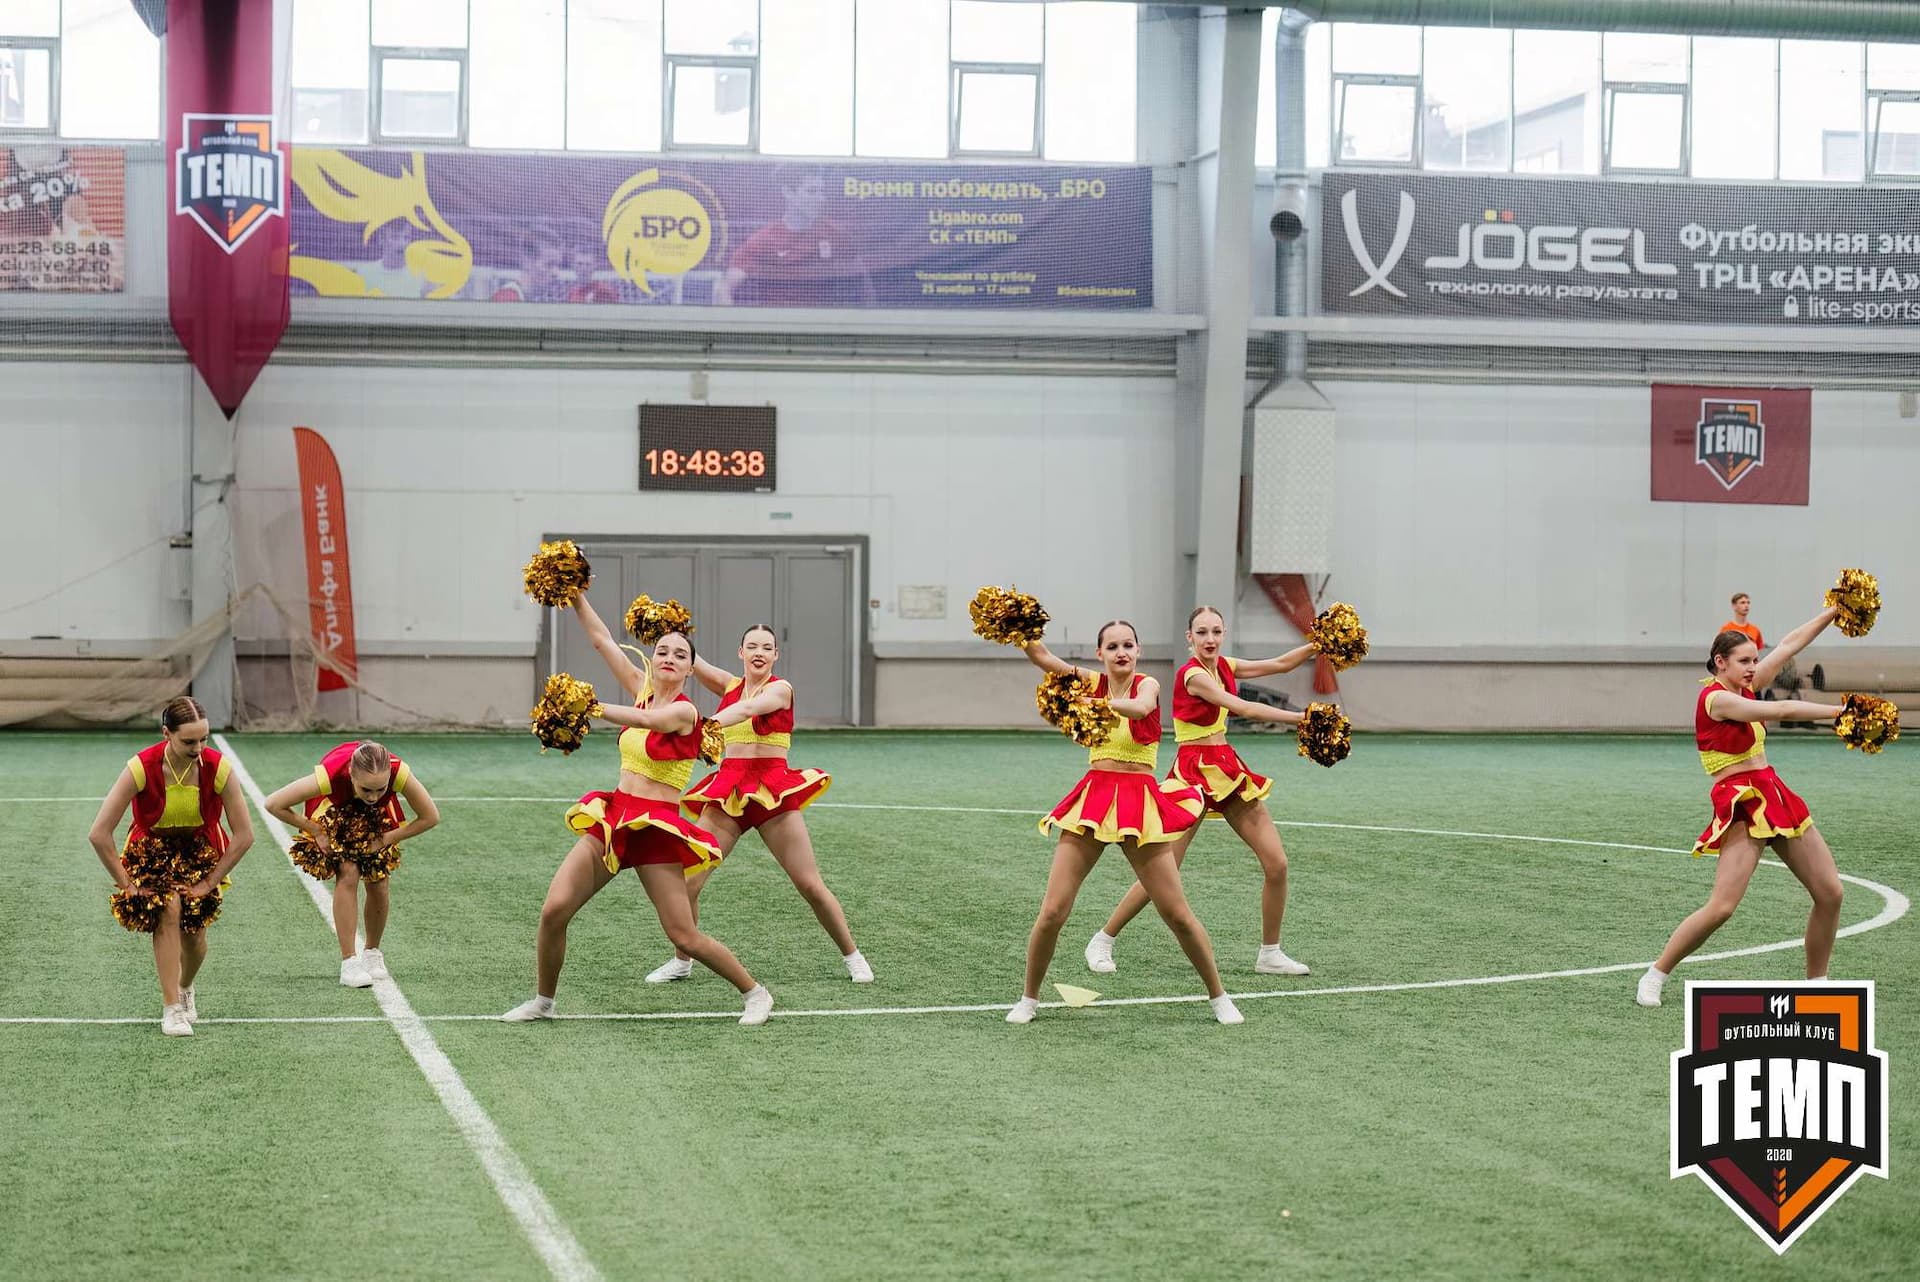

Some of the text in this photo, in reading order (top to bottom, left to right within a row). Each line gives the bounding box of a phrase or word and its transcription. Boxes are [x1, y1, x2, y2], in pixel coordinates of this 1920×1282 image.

[30, 168, 90, 203] 20%
[187, 153, 273, 201] ТЕМП
[844, 176, 1106, 201] Время побеждать, .БРО
[632, 214, 701, 239] .БРО
[929, 209, 1024, 225] Ligabro.com
[929, 229, 1018, 244] СК «ТЕМП»
[1425, 209, 1678, 275] JÖGEL
[1679, 222, 1868, 257] Футбольная
[1426, 280, 1678, 301] технологии результата
[1693, 262, 1920, 295] ТРЦ «АРЕНА»
[1703, 424, 1759, 457] ТЕМП
[645, 449, 766, 477] 18:48:38
